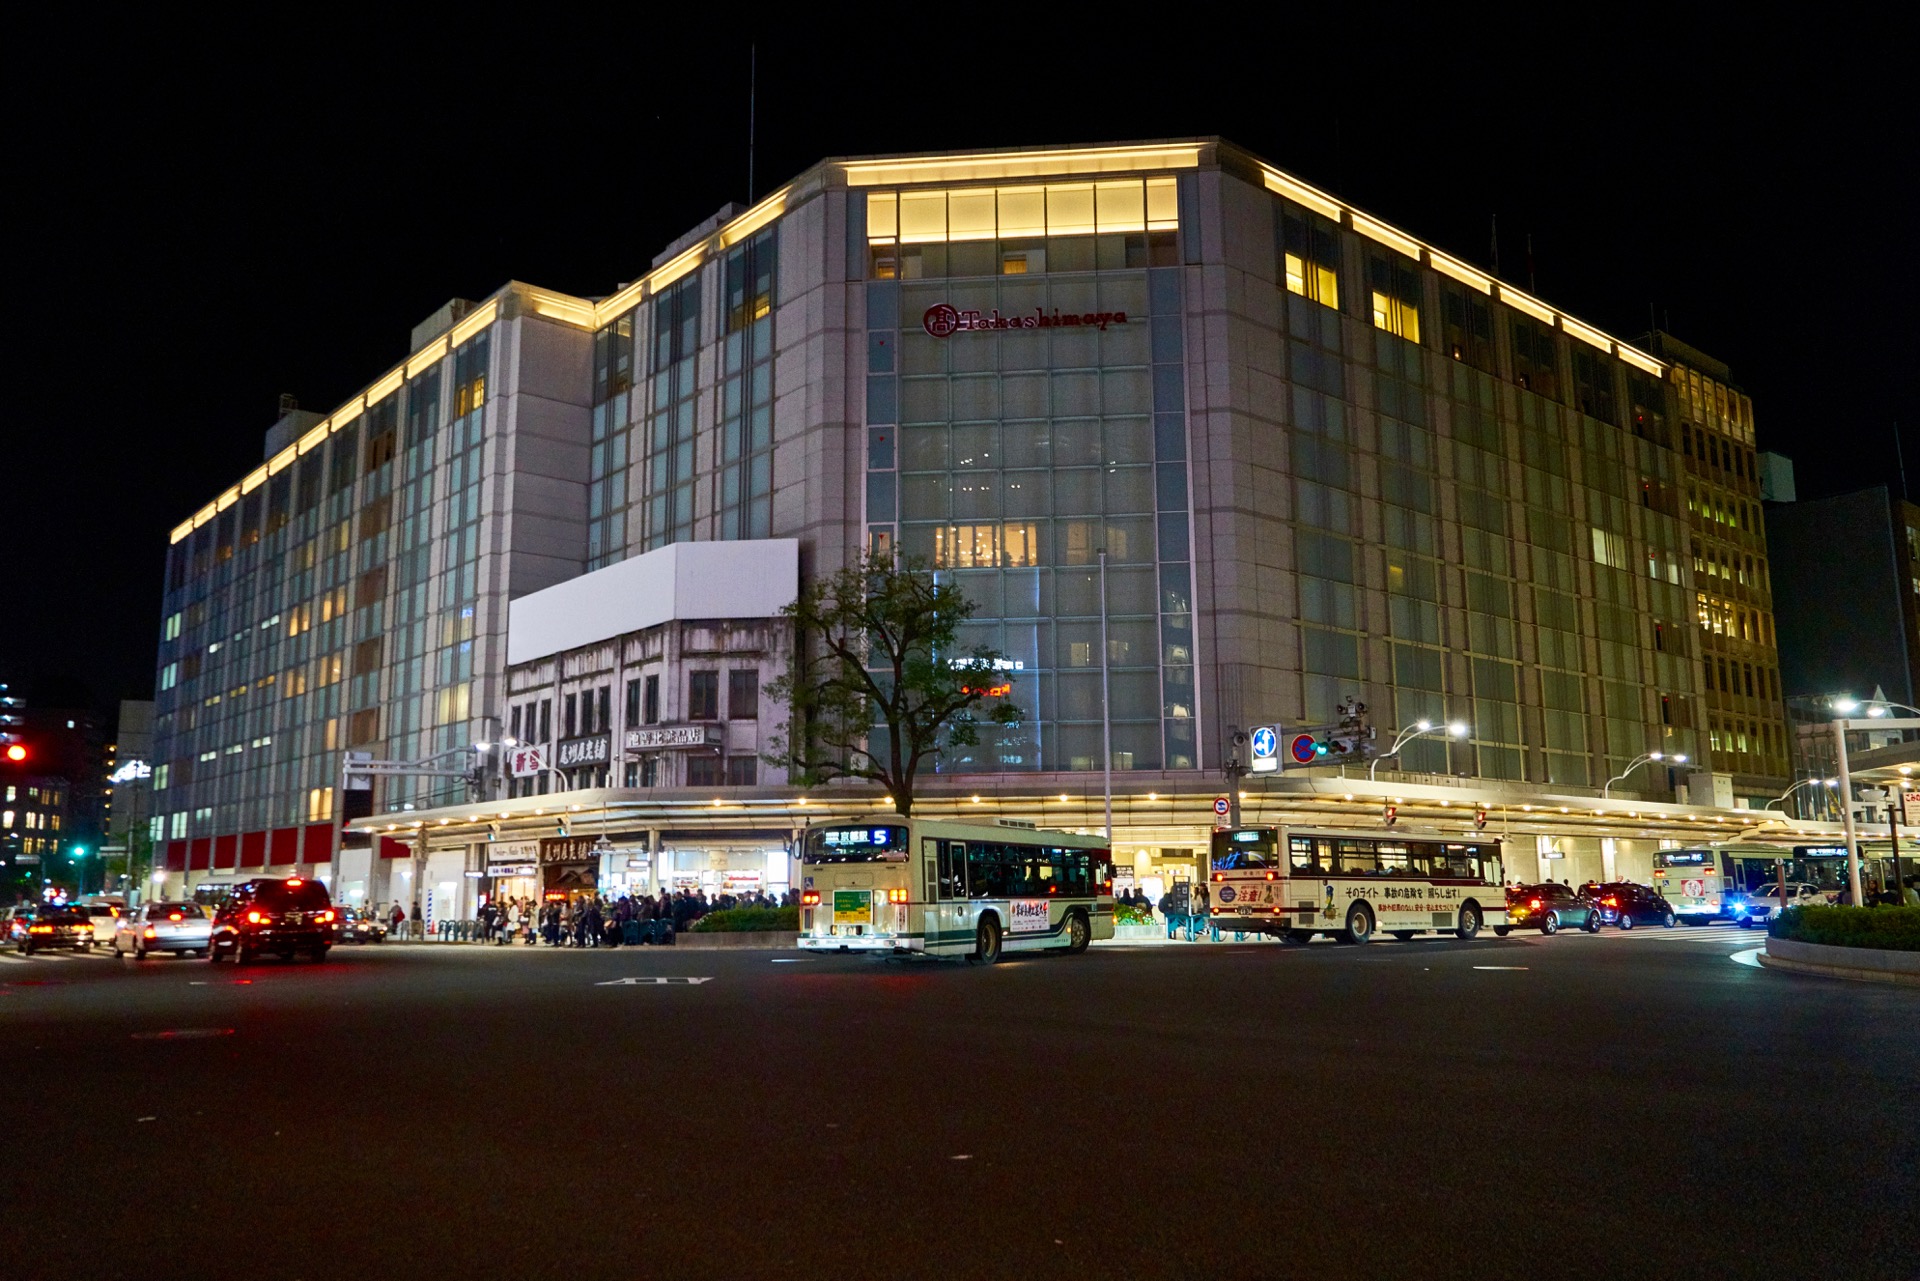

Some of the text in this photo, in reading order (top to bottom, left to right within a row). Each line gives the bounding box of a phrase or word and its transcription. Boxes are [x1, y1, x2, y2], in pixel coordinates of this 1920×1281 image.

[961, 308, 1127, 331] Takashimaya
[874, 830, 886, 845] 5
[1345, 887, 1379, 899] そのライト
[1384, 887, 1423, 899] 事故の危険を
